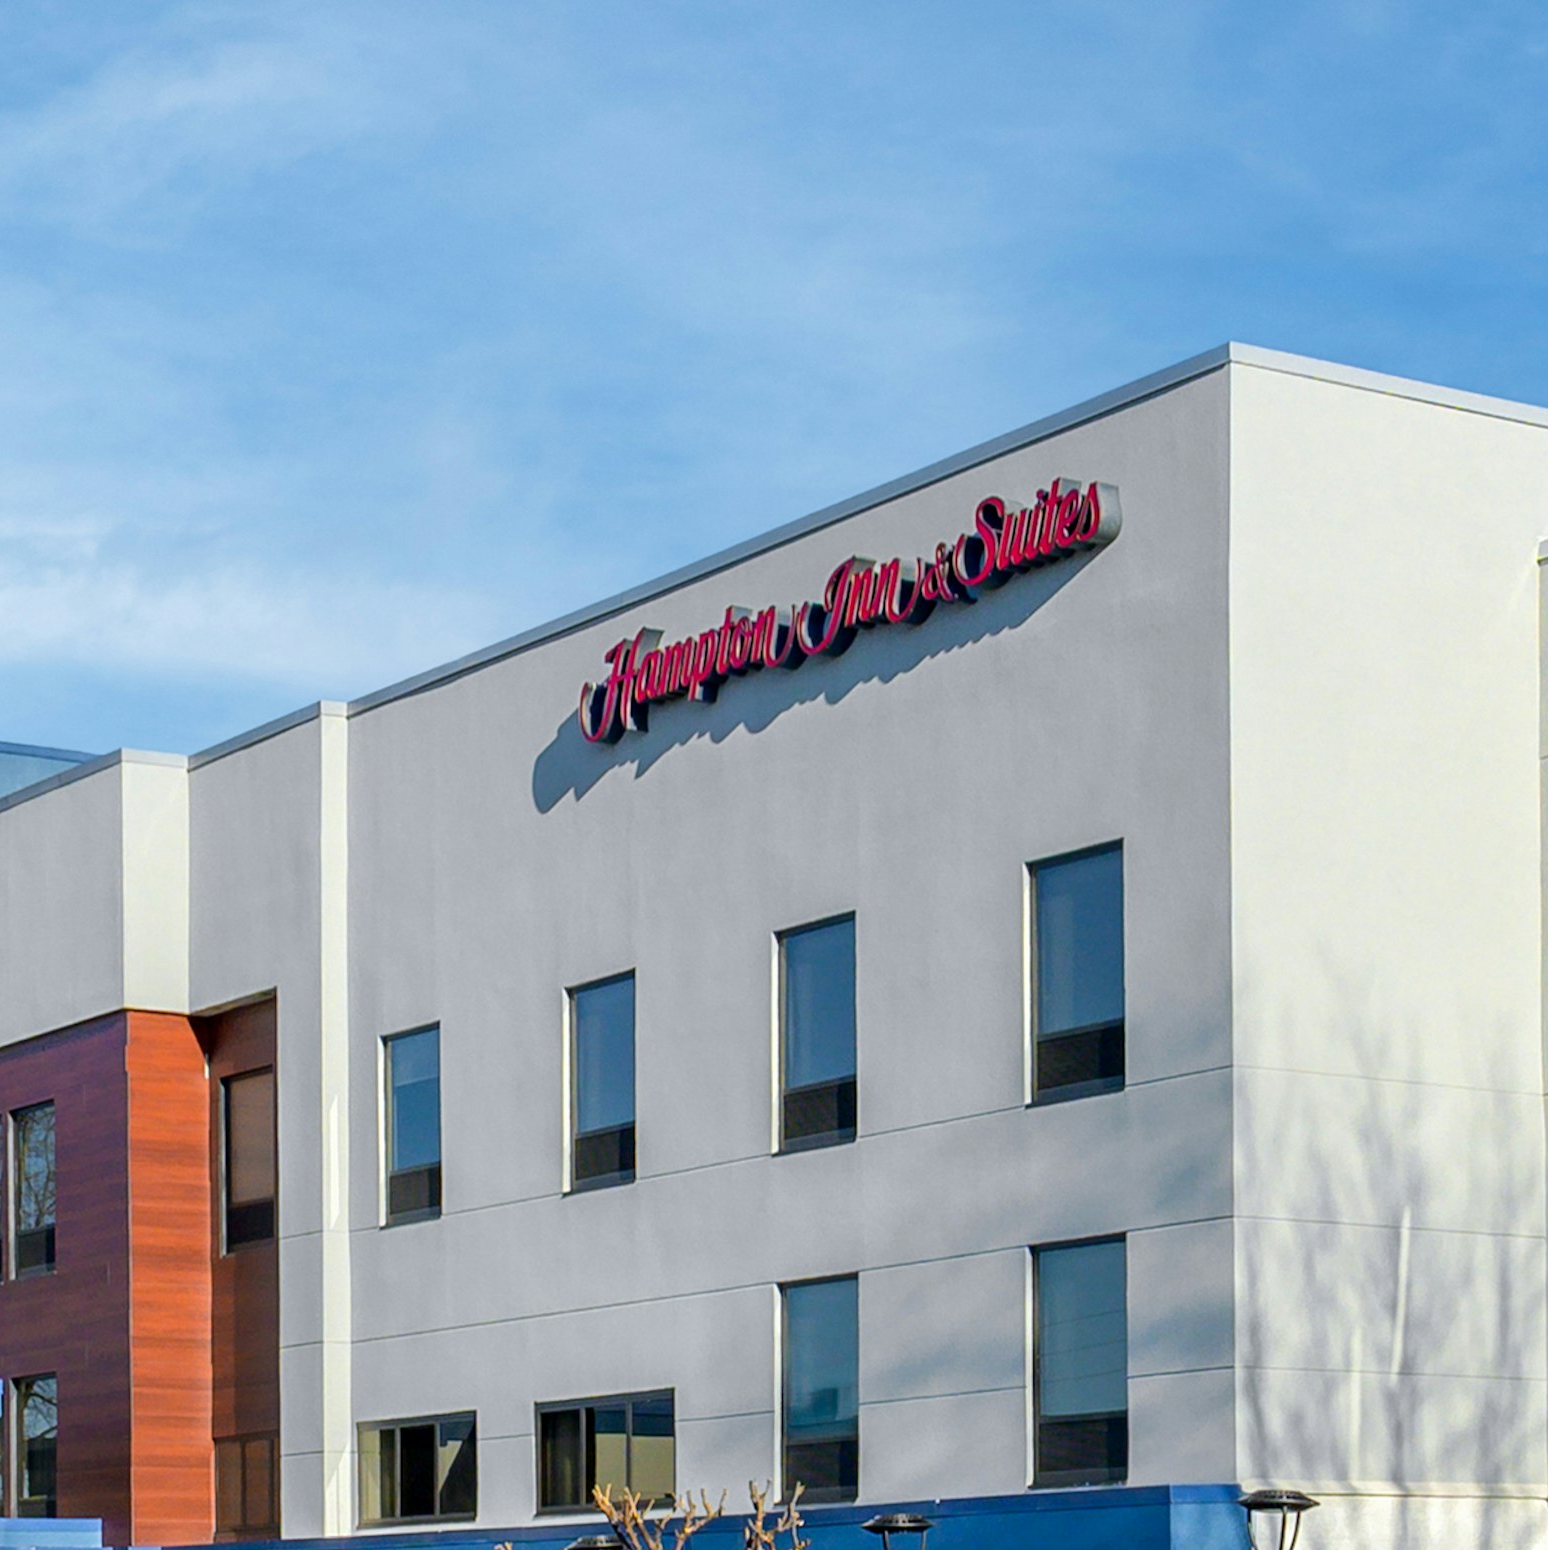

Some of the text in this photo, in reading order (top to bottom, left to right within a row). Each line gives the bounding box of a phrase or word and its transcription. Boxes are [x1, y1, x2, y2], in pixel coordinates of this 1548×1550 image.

[579, 477, 1101, 743] Hampton Inn & Suites
